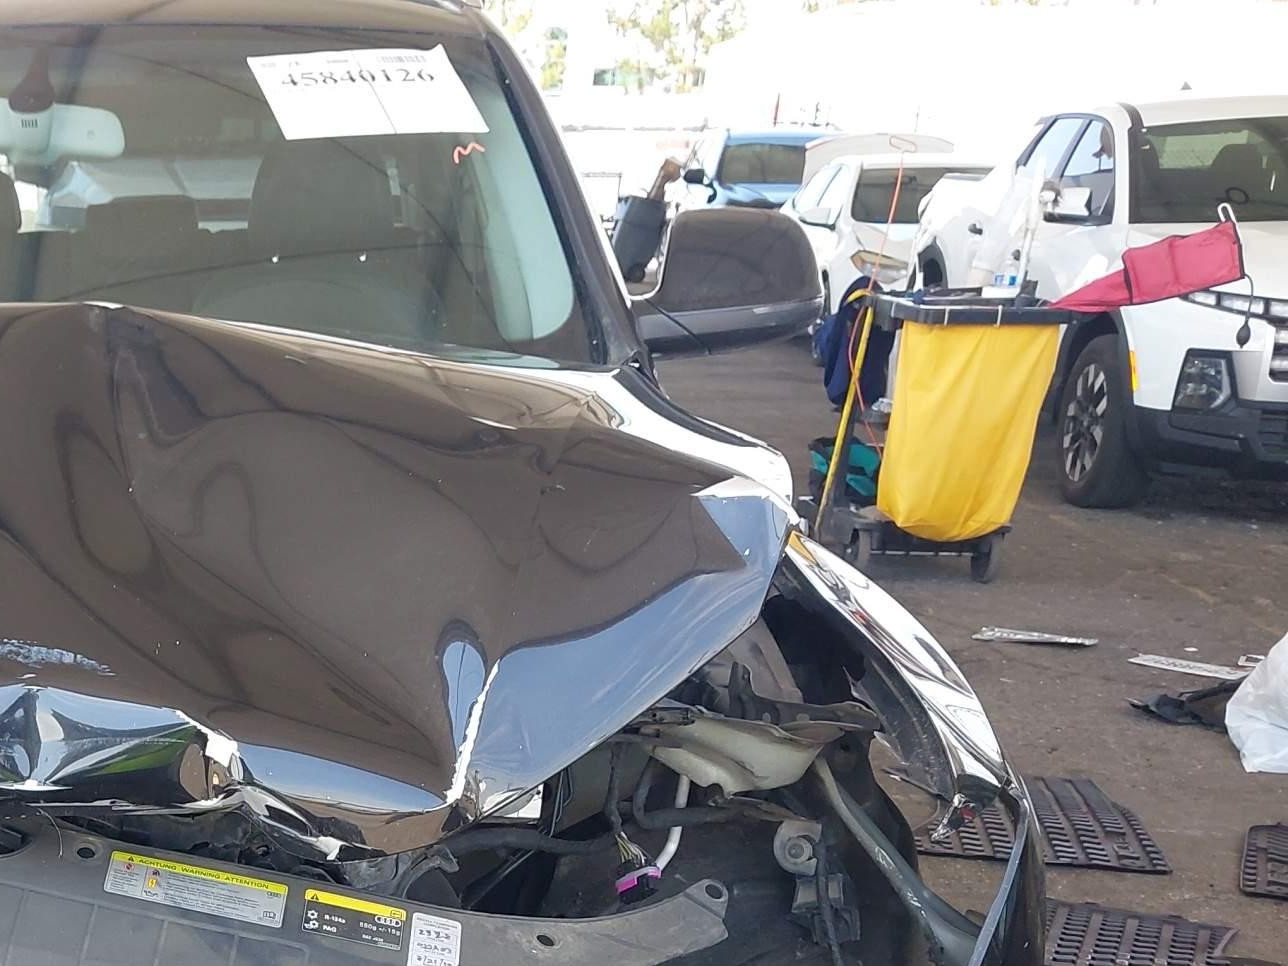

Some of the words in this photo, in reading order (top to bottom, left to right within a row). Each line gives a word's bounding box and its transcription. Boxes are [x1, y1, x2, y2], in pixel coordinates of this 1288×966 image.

[282, 68, 434, 86] 45840126
[138, 858, 177, 871] ACHTUNG
[181, 866, 222, 880] WARNING
[223, 874, 269, 890] ATTENTION
